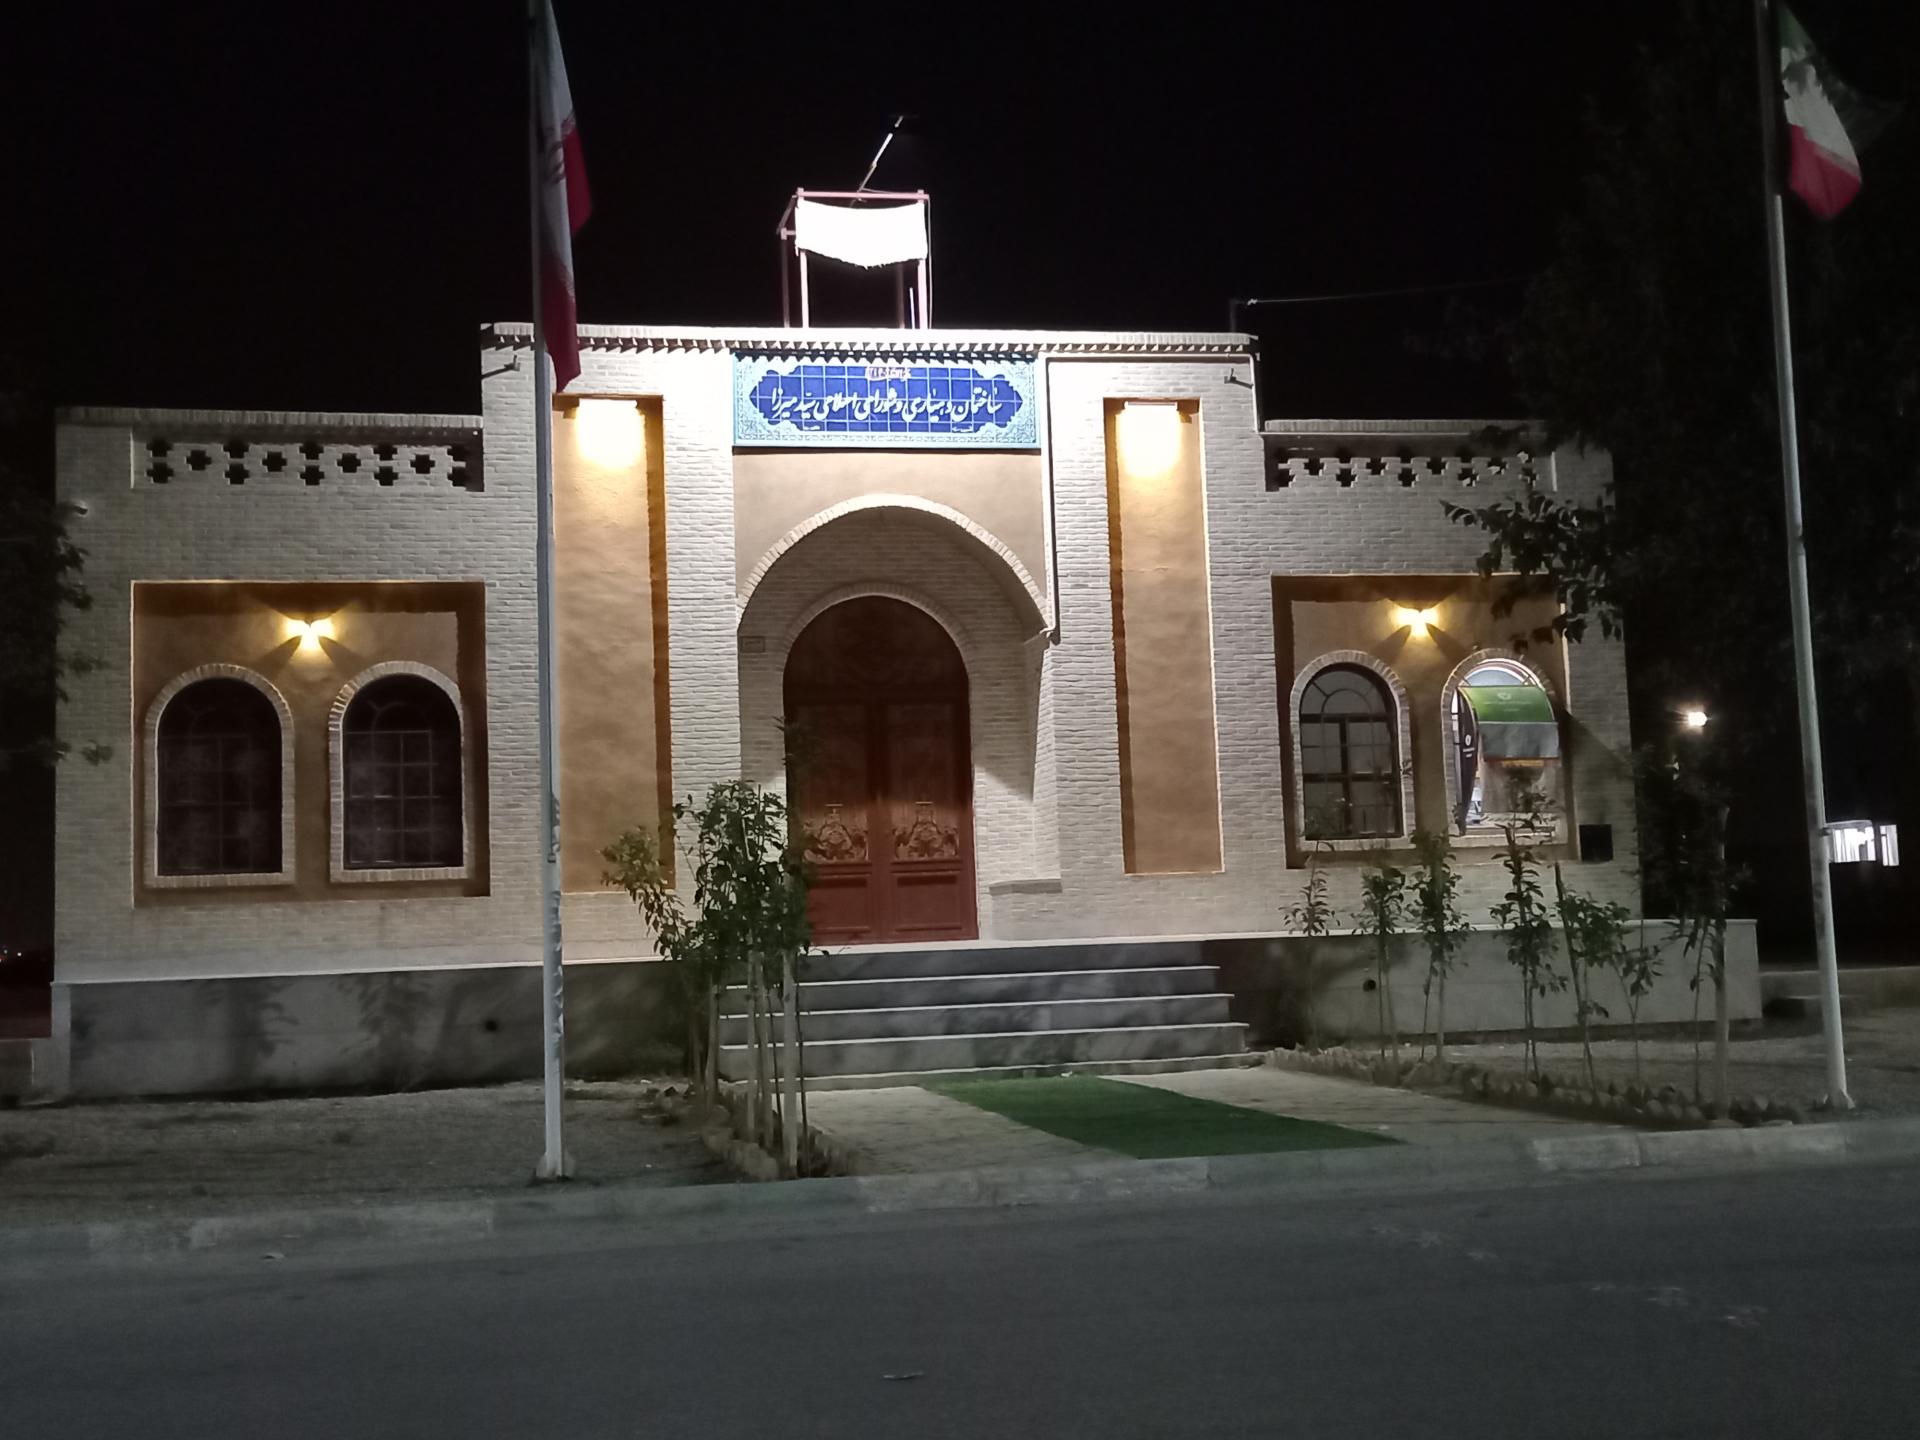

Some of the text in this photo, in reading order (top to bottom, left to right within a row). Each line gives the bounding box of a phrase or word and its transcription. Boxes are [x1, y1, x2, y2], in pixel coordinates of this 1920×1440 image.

[813, 392, 858, 421] اسلامی
[901, 388, 952, 422] دهیاری
[950, 387, 1002, 422] ساختمان
